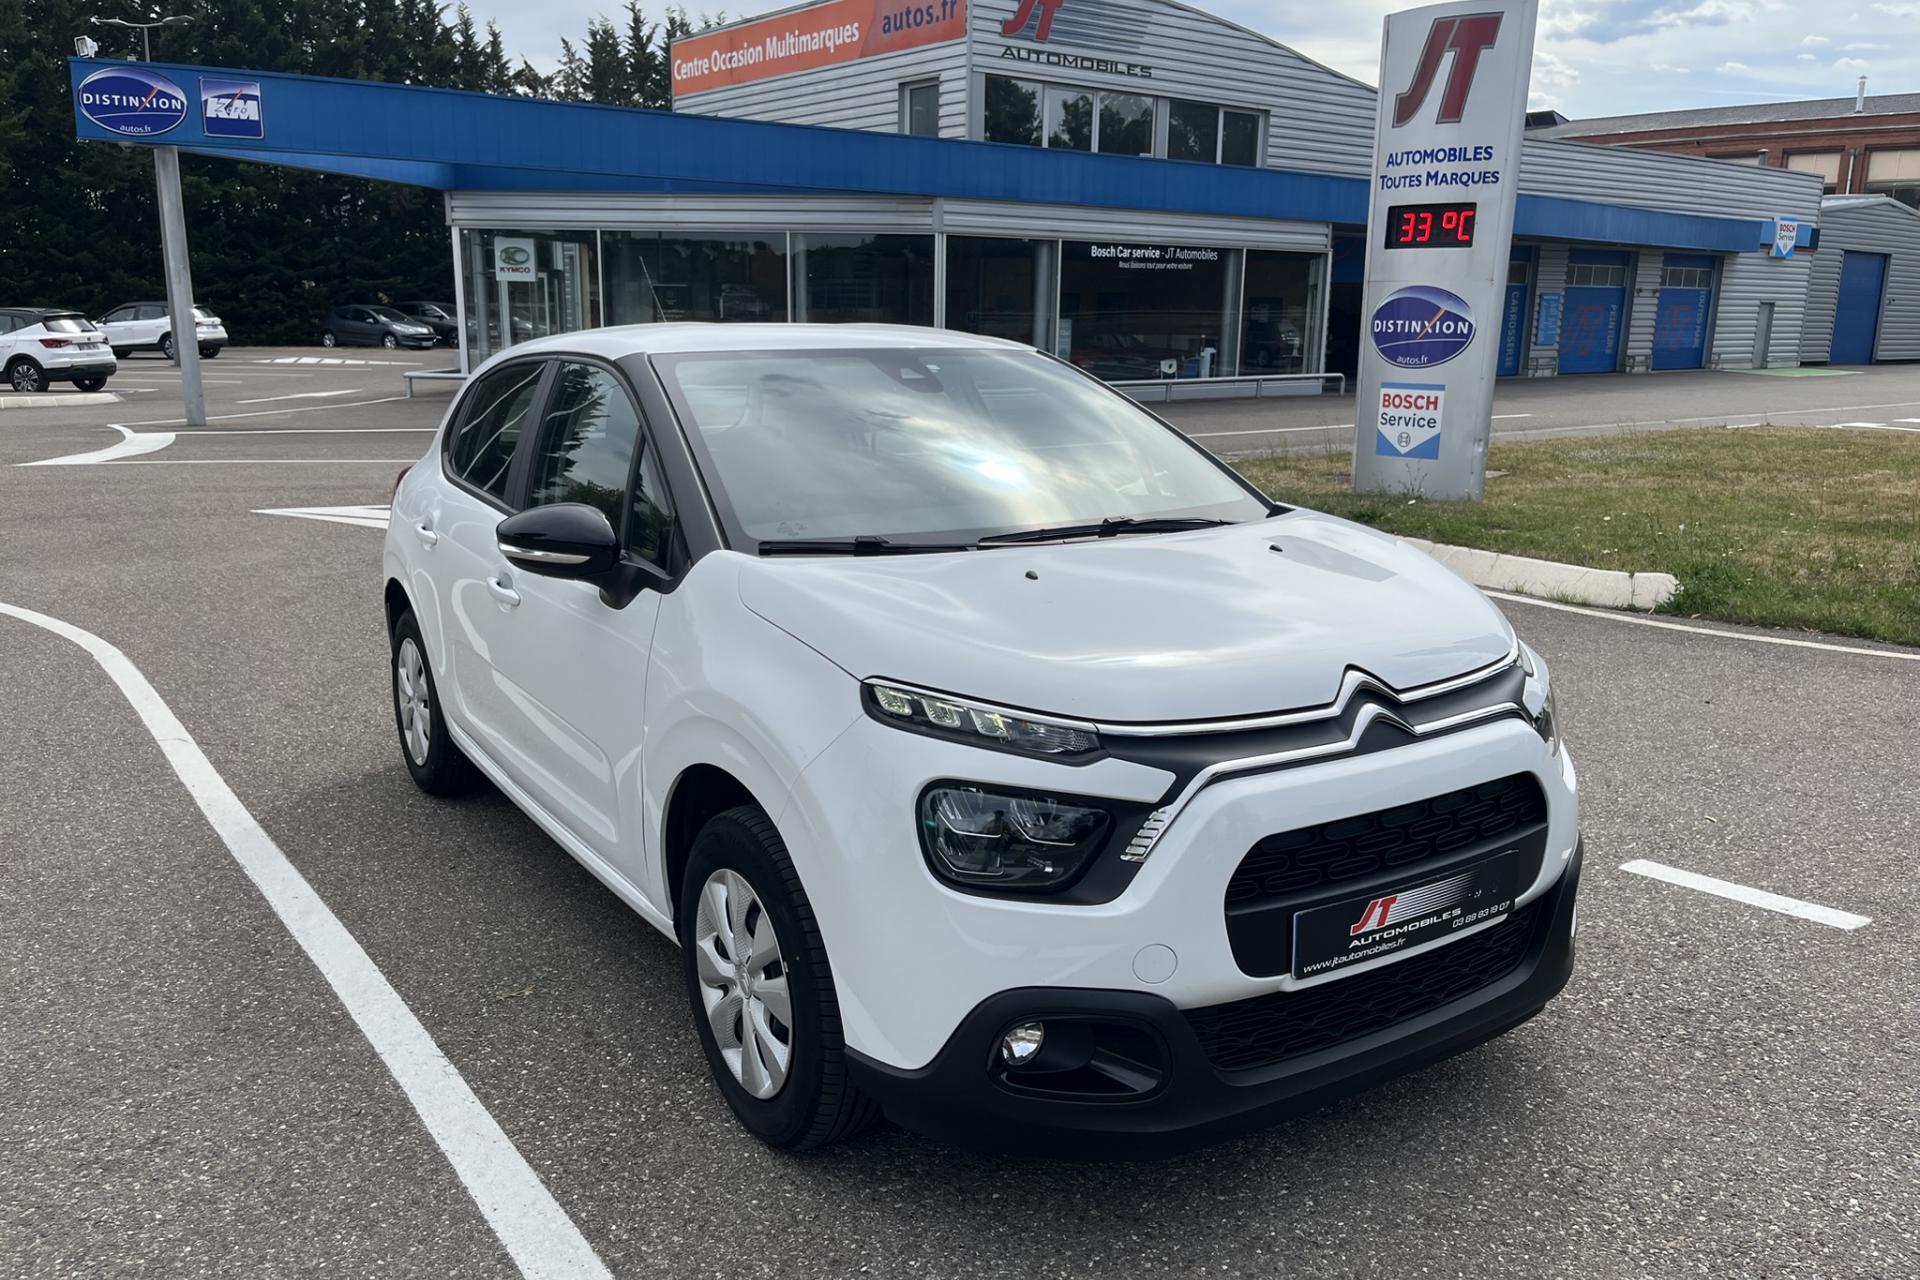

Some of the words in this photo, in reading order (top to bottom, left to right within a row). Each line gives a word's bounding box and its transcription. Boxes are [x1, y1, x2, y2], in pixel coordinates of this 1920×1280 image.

[882, 0, 956, 34] autos.fr
[674, 57, 709, 80] Centre
[711, 42, 763, 70] Occasion
[765, 22, 860, 61] Multimarques
[1000, 46, 1153, 78] AUTOMOBILES
[1392, 11, 1504, 128] JT
[82, 91, 182, 111] DISTINXION
[119, 123, 151, 134] autos.fr
[1386, 145, 1494, 168] AUTOMOBILES
[1379, 174, 1422, 190] TOUTES
[1425, 170, 1500, 188] MARQUES
[1400, 211, 1434, 242] 33
[1778, 232, 1795, 241] Service
[1780, 223, 1796, 233] BOSCH
[1091, 245, 1116, 258] Bosch
[1117, 246, 1131, 258] Car
[1132, 247, 1160, 259] service
[1165, 248, 1175, 259] JT
[1175, 248, 1218, 260] Automobiles
[500, 266, 531, 274] KYMCO
[1374, 318, 1469, 335] DISTINXION
[1397, 354, 1428, 365] autos.fr
[1382, 393, 1439, 411] BOSCH
[1380, 412, 1437, 429] Service
[1350, 895, 1399, 936] JT
[1452, 917, 1465, 928] 03
[1499, 900, 1510, 911] 07
[1348, 907, 1461, 949] AUTOMOBILES
[1303, 937, 1406, 974] www.jtautomobiles.fr
